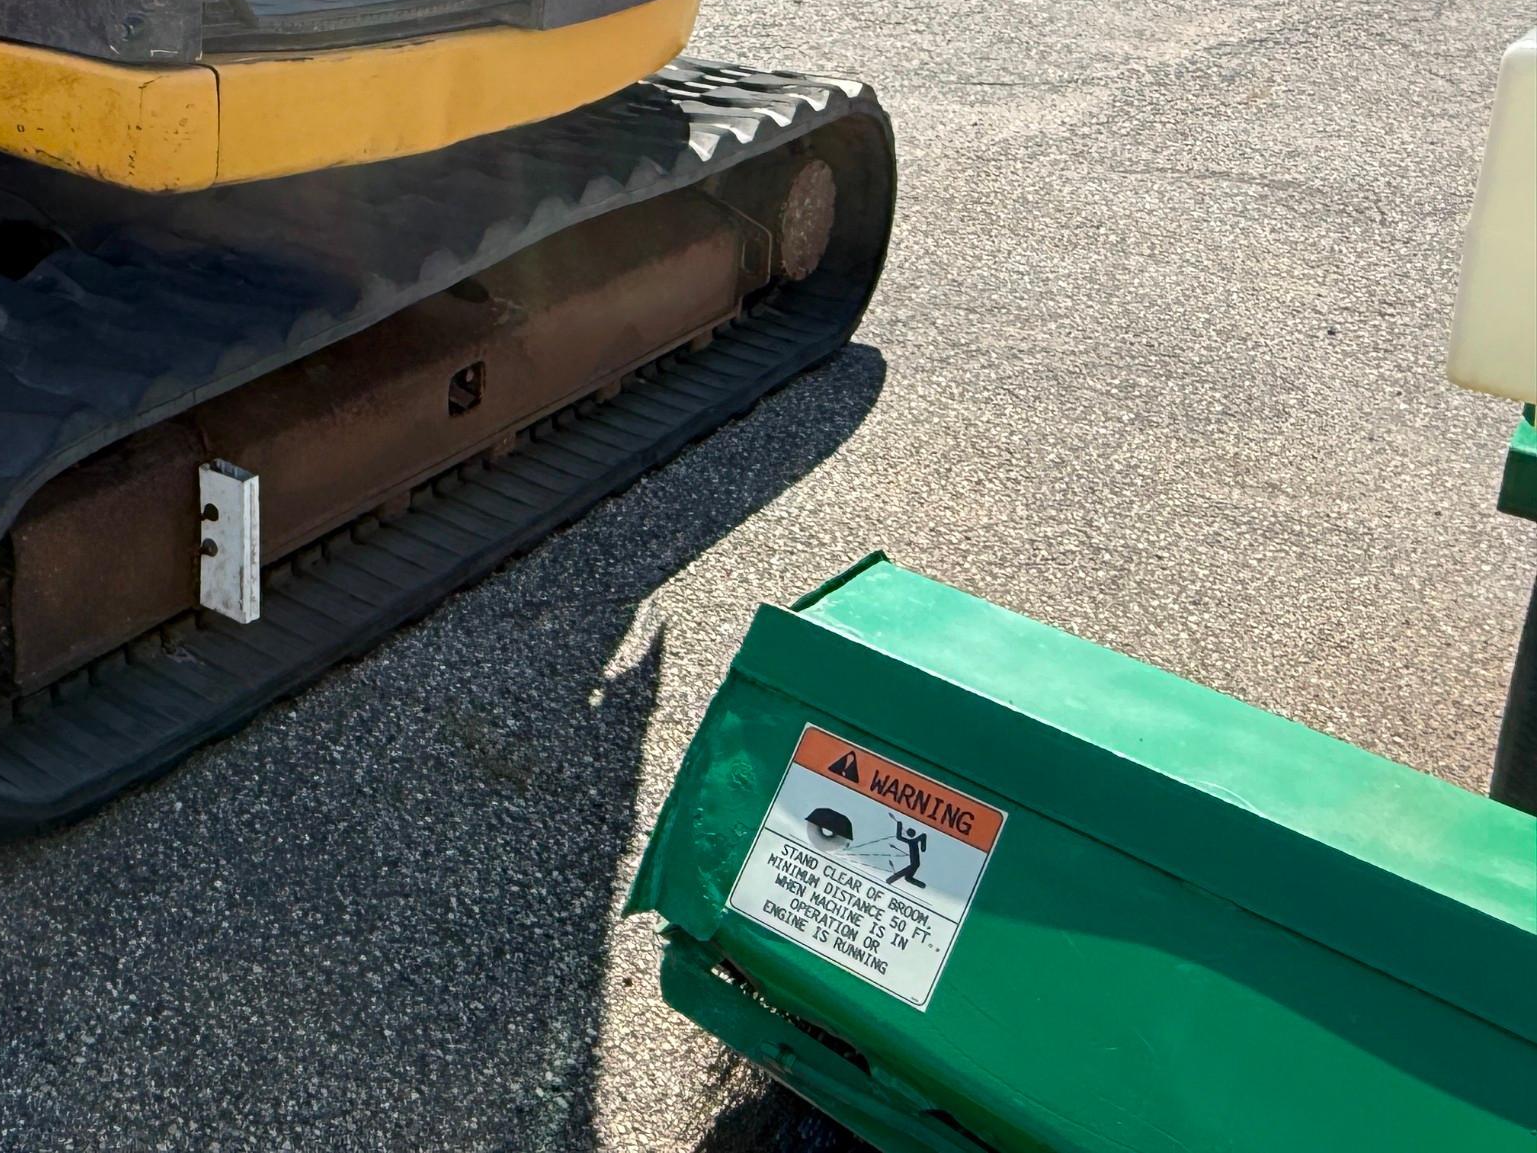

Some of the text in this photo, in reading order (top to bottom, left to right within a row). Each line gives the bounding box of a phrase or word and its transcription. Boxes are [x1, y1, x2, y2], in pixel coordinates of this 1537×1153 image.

[869, 769, 974, 835] WARNING
[767, 852, 820, 888] MINIMUM
[823, 881, 885, 921] DISTANCE
[888, 915, 906, 932] 50
[781, 843, 818, 870] STAND
[822, 864, 862, 893] CLEAR
[866, 886, 884, 901] OF
[762, 899, 888, 975] ENGINE IS RUNNING
[774, 872, 908, 950] WHEN MACHINE IS IN
[789, 897, 880, 953] OPERATION OR
